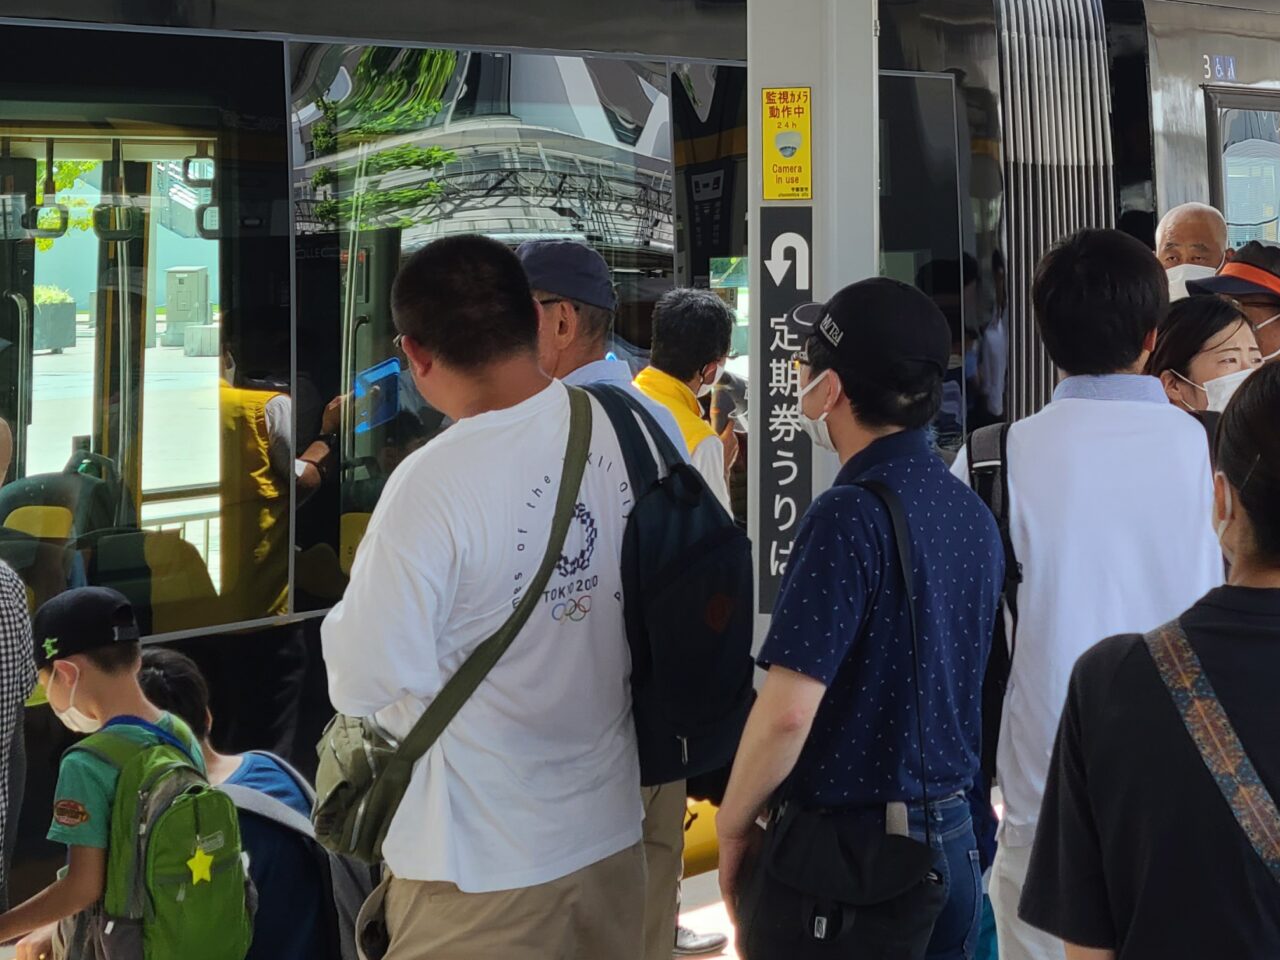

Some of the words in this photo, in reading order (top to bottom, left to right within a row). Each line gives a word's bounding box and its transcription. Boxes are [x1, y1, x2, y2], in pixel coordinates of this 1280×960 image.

[1203, 54, 1211, 79] 3
[765, 91, 808, 105] 監視カメラ
[768, 105, 804, 119] 動作中
[772, 164, 802, 174] Camera
[785, 175, 799, 184] use
[527, 475, 551, 510] the
